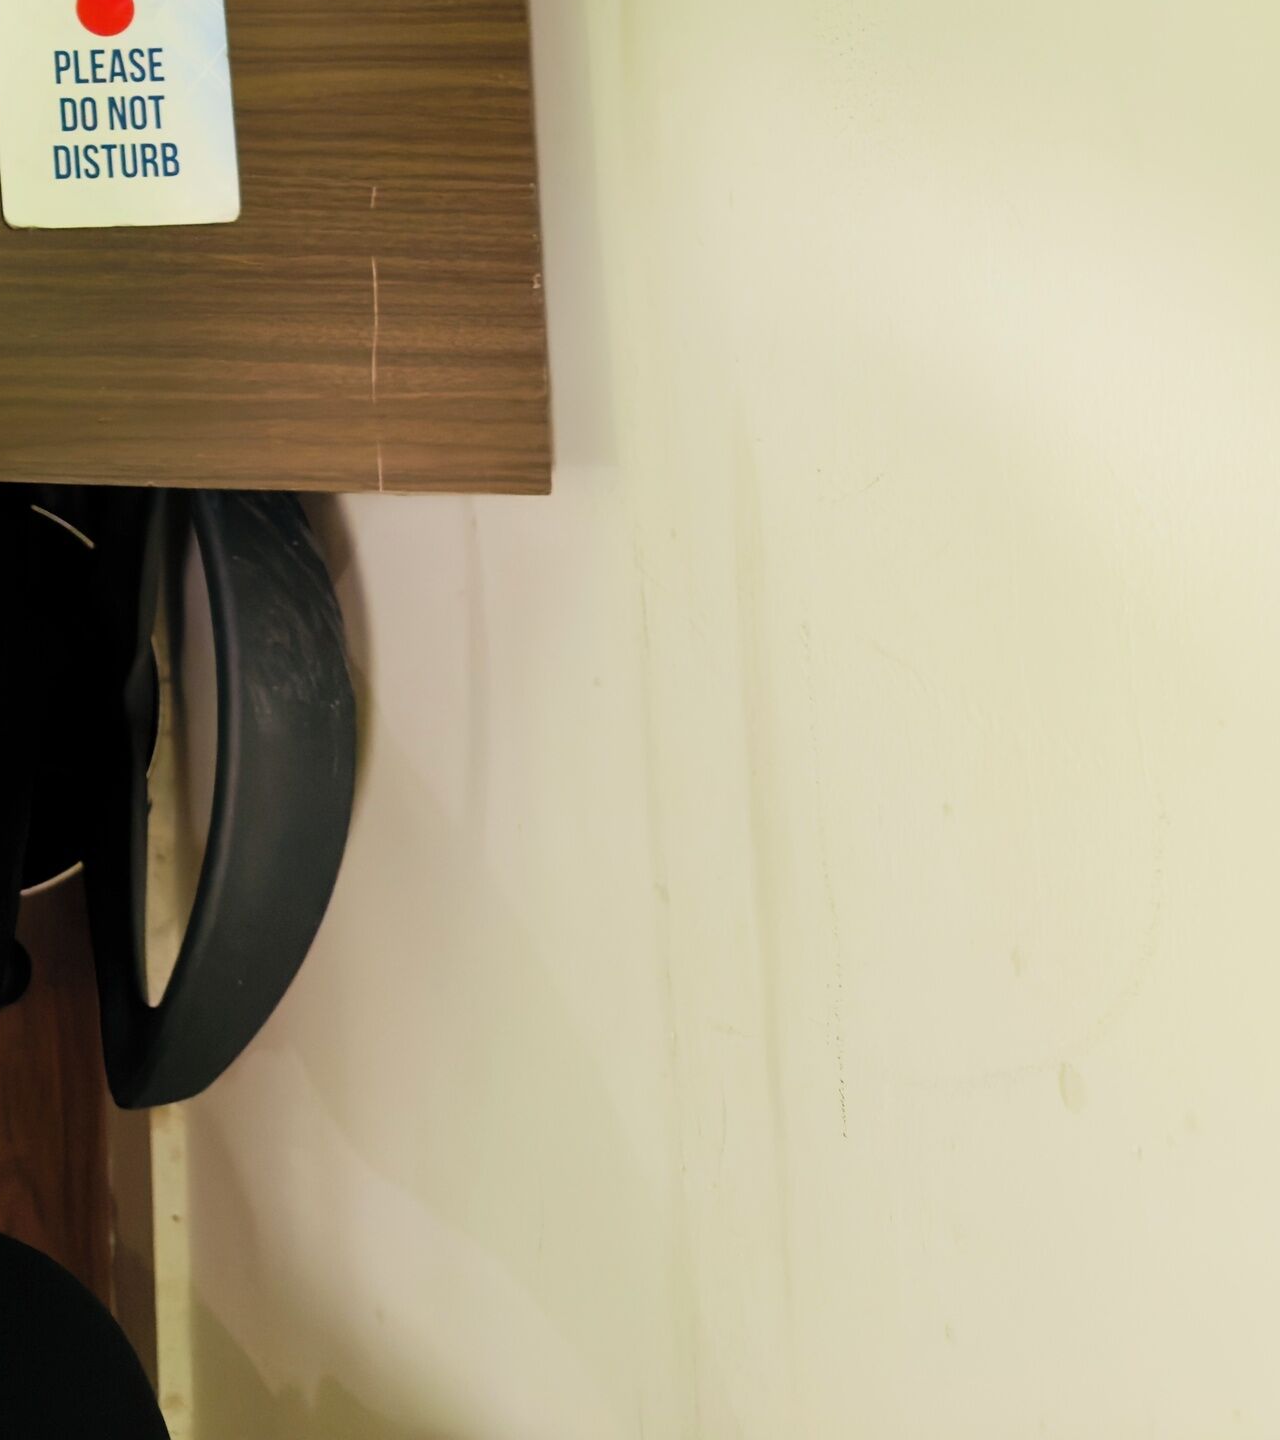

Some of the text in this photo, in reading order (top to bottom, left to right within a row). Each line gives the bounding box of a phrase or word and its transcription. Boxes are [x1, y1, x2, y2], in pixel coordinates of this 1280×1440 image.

[54, 47, 165, 84] PLEASE
[59, 95, 165, 132] DO NOT
[53, 142, 180, 180] DISTURB
